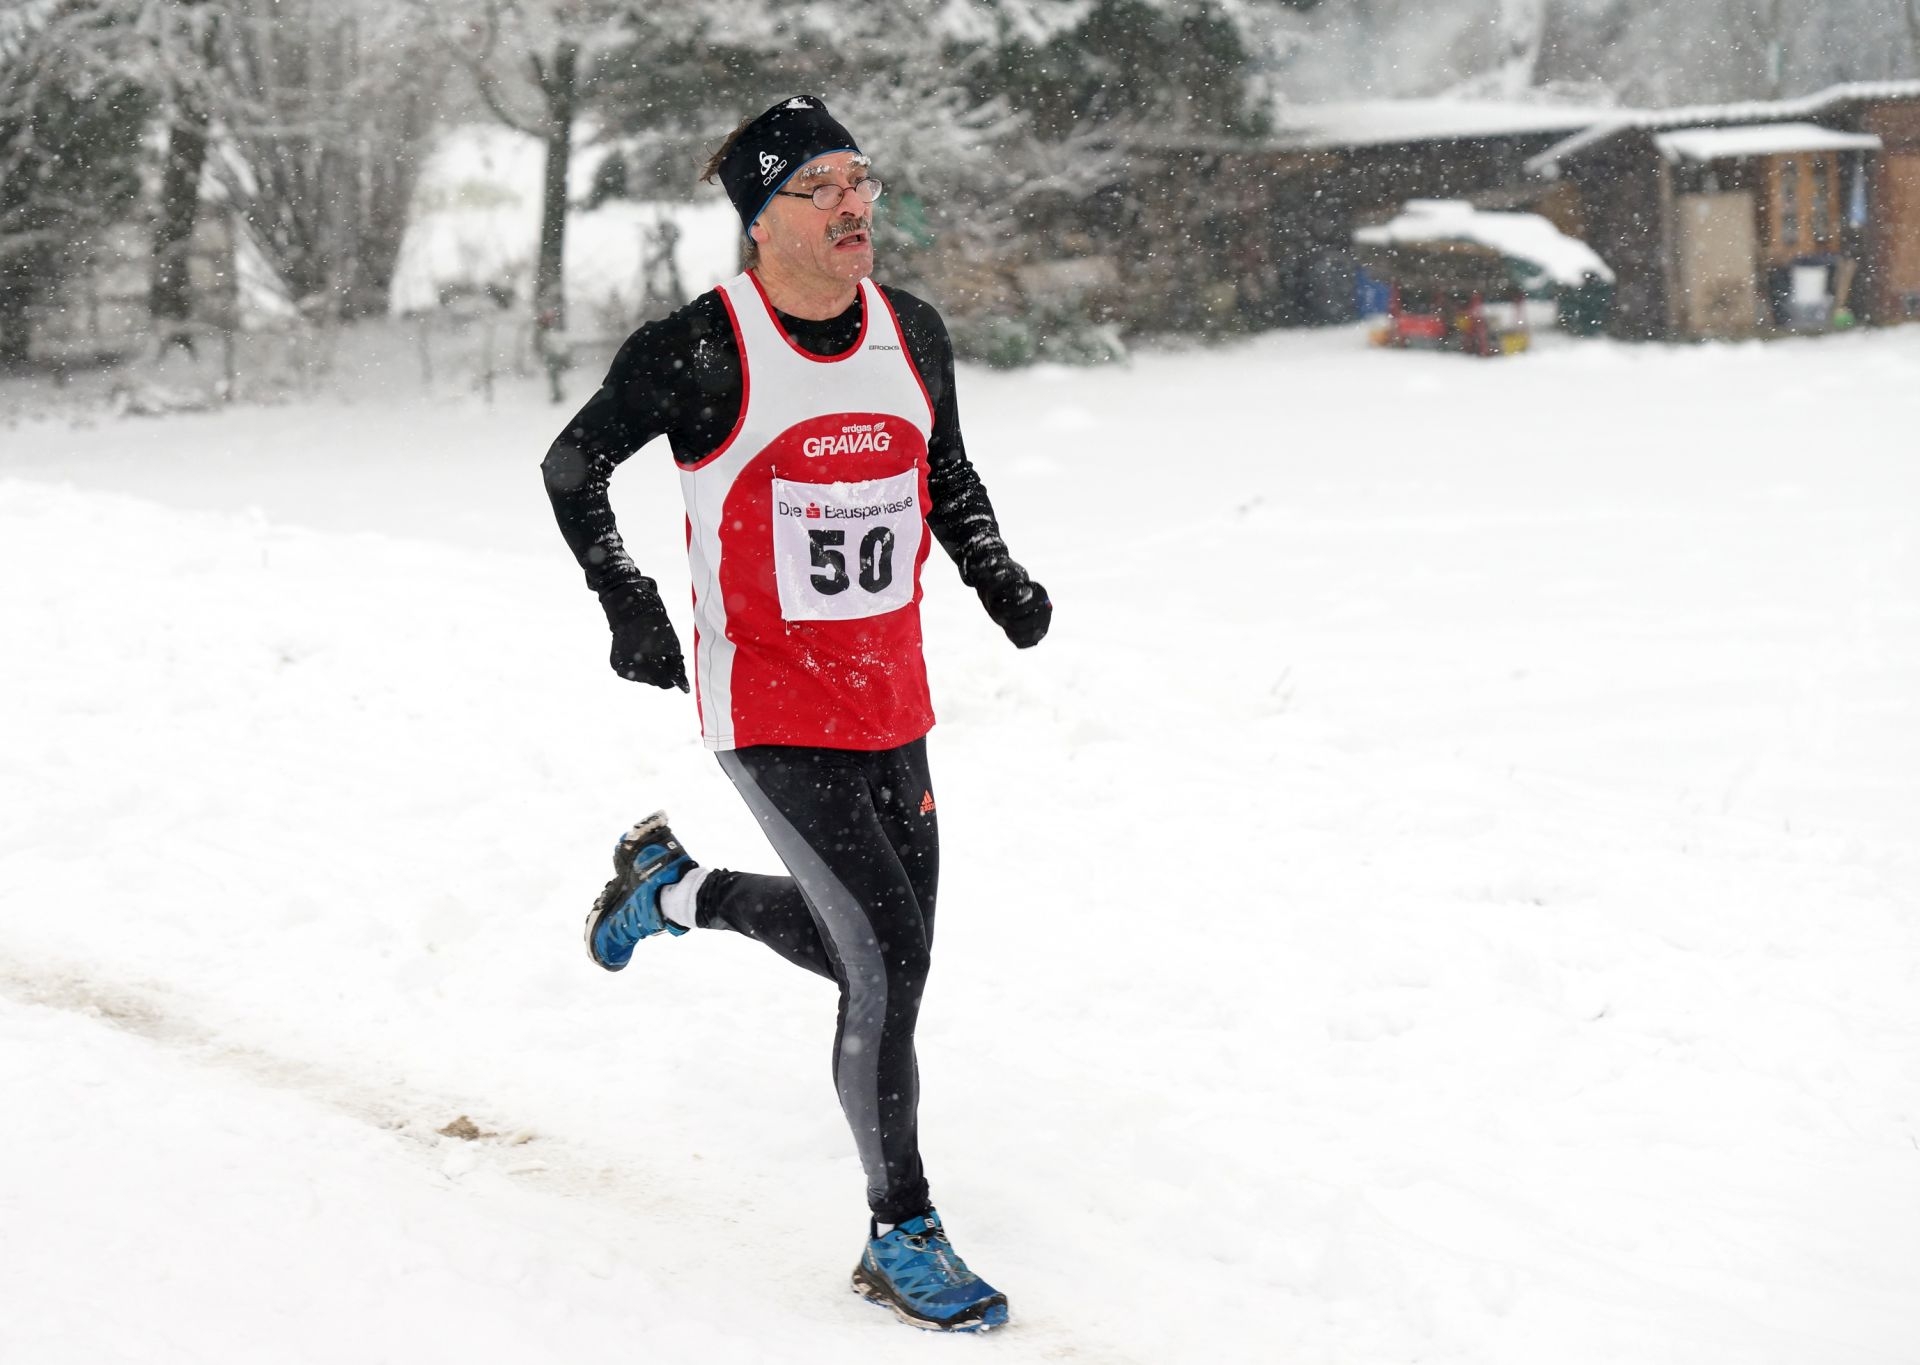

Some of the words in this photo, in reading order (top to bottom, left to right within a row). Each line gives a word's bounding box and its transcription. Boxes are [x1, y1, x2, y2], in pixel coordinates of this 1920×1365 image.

[763, 160, 787, 186] odlo
[842, 424, 872, 433] erdgas
[803, 432, 892, 457] GRAVAG
[779, 502, 802, 517] Die
[808, 526, 894, 595] 50
